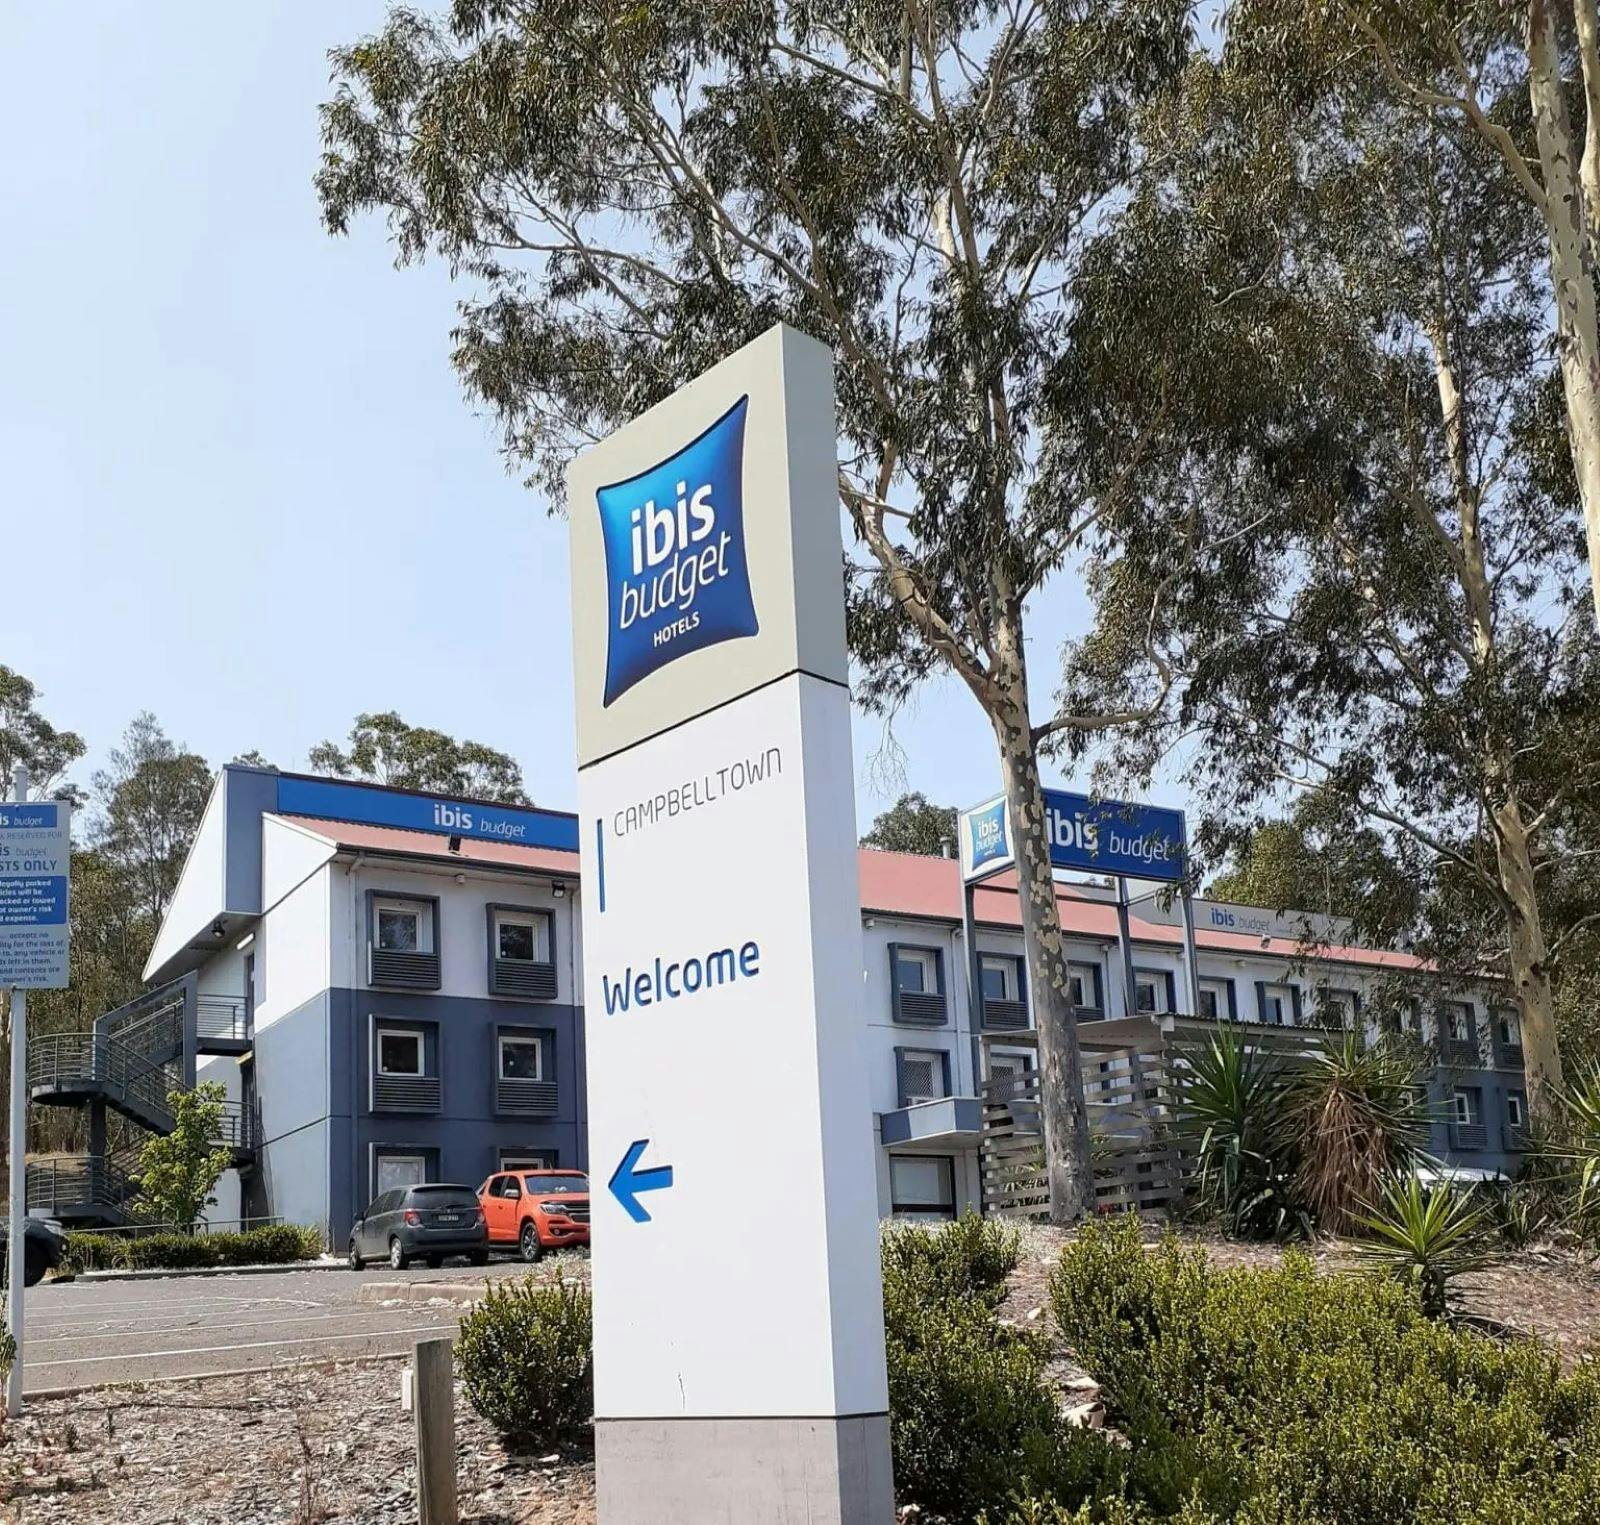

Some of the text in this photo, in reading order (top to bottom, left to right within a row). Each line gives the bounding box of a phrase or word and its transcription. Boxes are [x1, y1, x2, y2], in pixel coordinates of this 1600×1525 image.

[631, 480, 715, 575] ibis
[620, 530, 731, 629] budget
[653, 611, 700, 648] HOTELS
[614, 747, 781, 837] CAMPBELLTOWN
[14, 815, 43, 827] budget
[433, 803, 526, 838] ibis budget
[978, 816, 999, 839] ibis
[1046, 807, 1171, 863] ibis budget
[24, 860, 57, 871] ONLY
[1211, 908, 1270, 933] ibis budget
[603, 941, 760, 1016] Welcome
